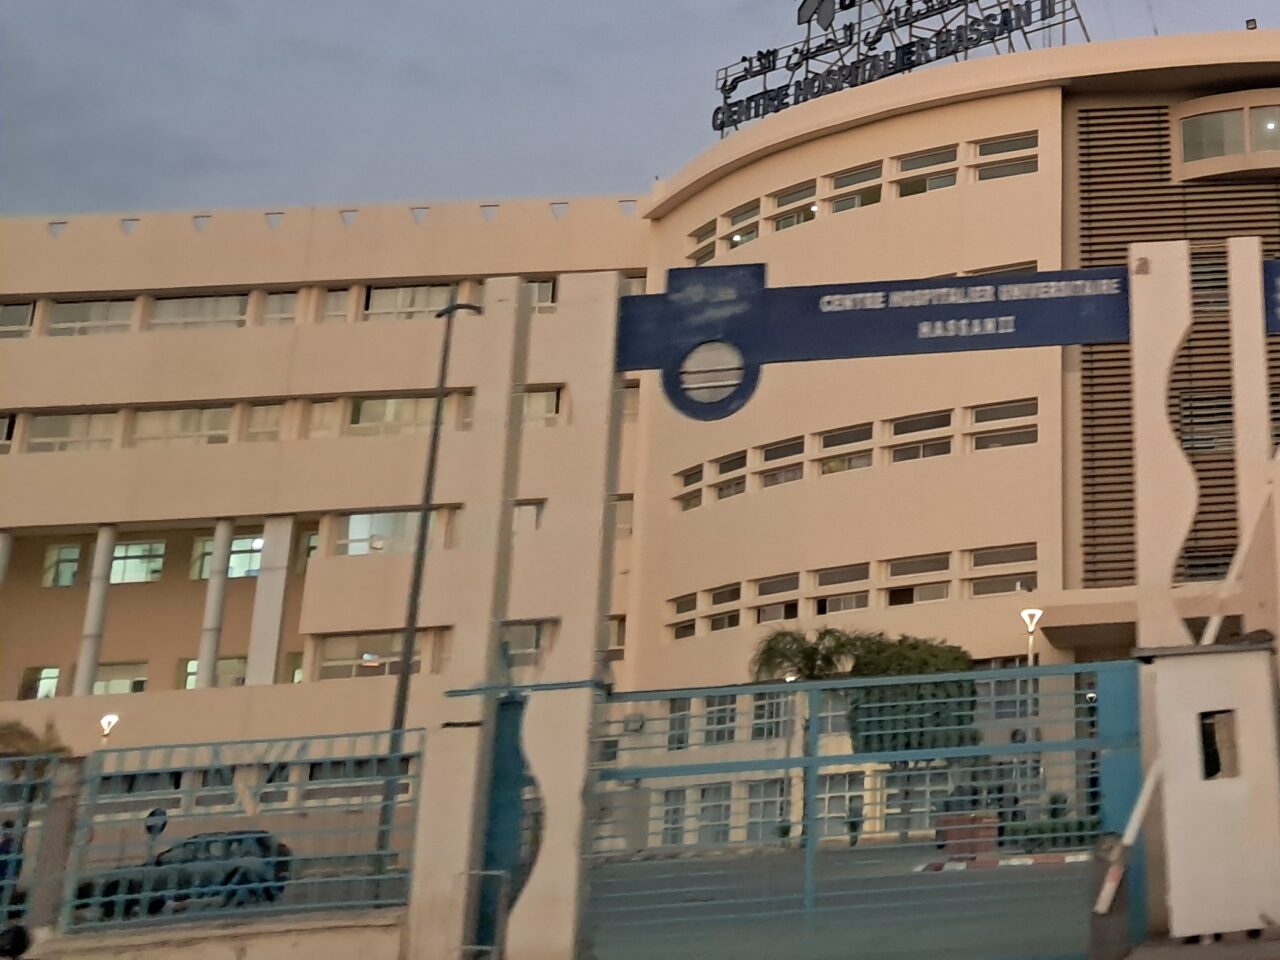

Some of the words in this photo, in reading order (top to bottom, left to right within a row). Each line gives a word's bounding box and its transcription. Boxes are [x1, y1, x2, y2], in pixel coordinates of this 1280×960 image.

[712, 83, 790, 131] CENTRE
[794, 37, 931, 105] HOSPITALIER
[936, 0, 1033, 57] HASSAN
